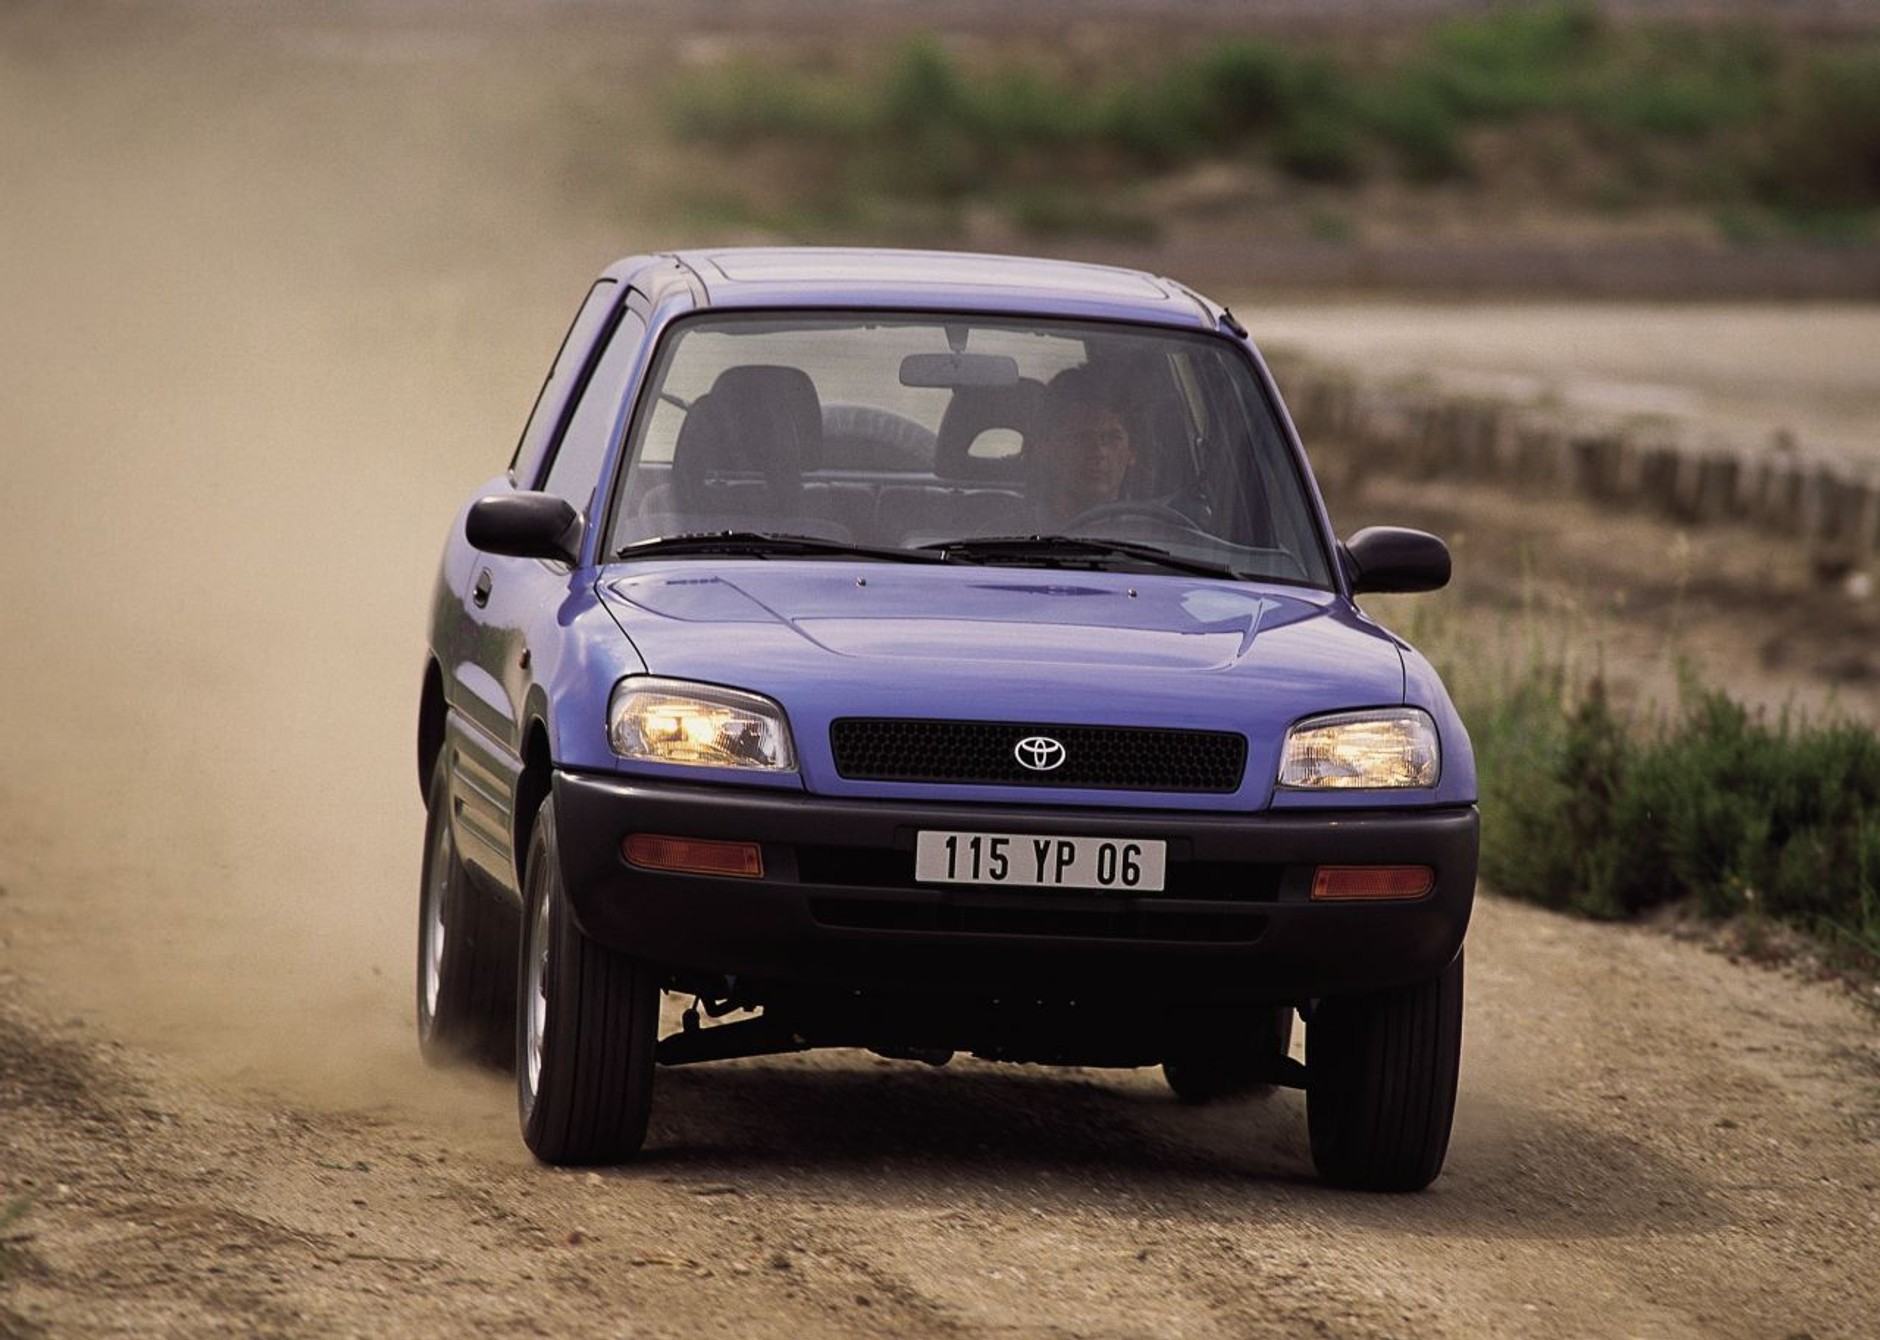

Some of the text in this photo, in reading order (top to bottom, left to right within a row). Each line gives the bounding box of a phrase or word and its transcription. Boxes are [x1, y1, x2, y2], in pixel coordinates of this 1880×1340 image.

[945, 835, 1142, 887] 115 YP 06
